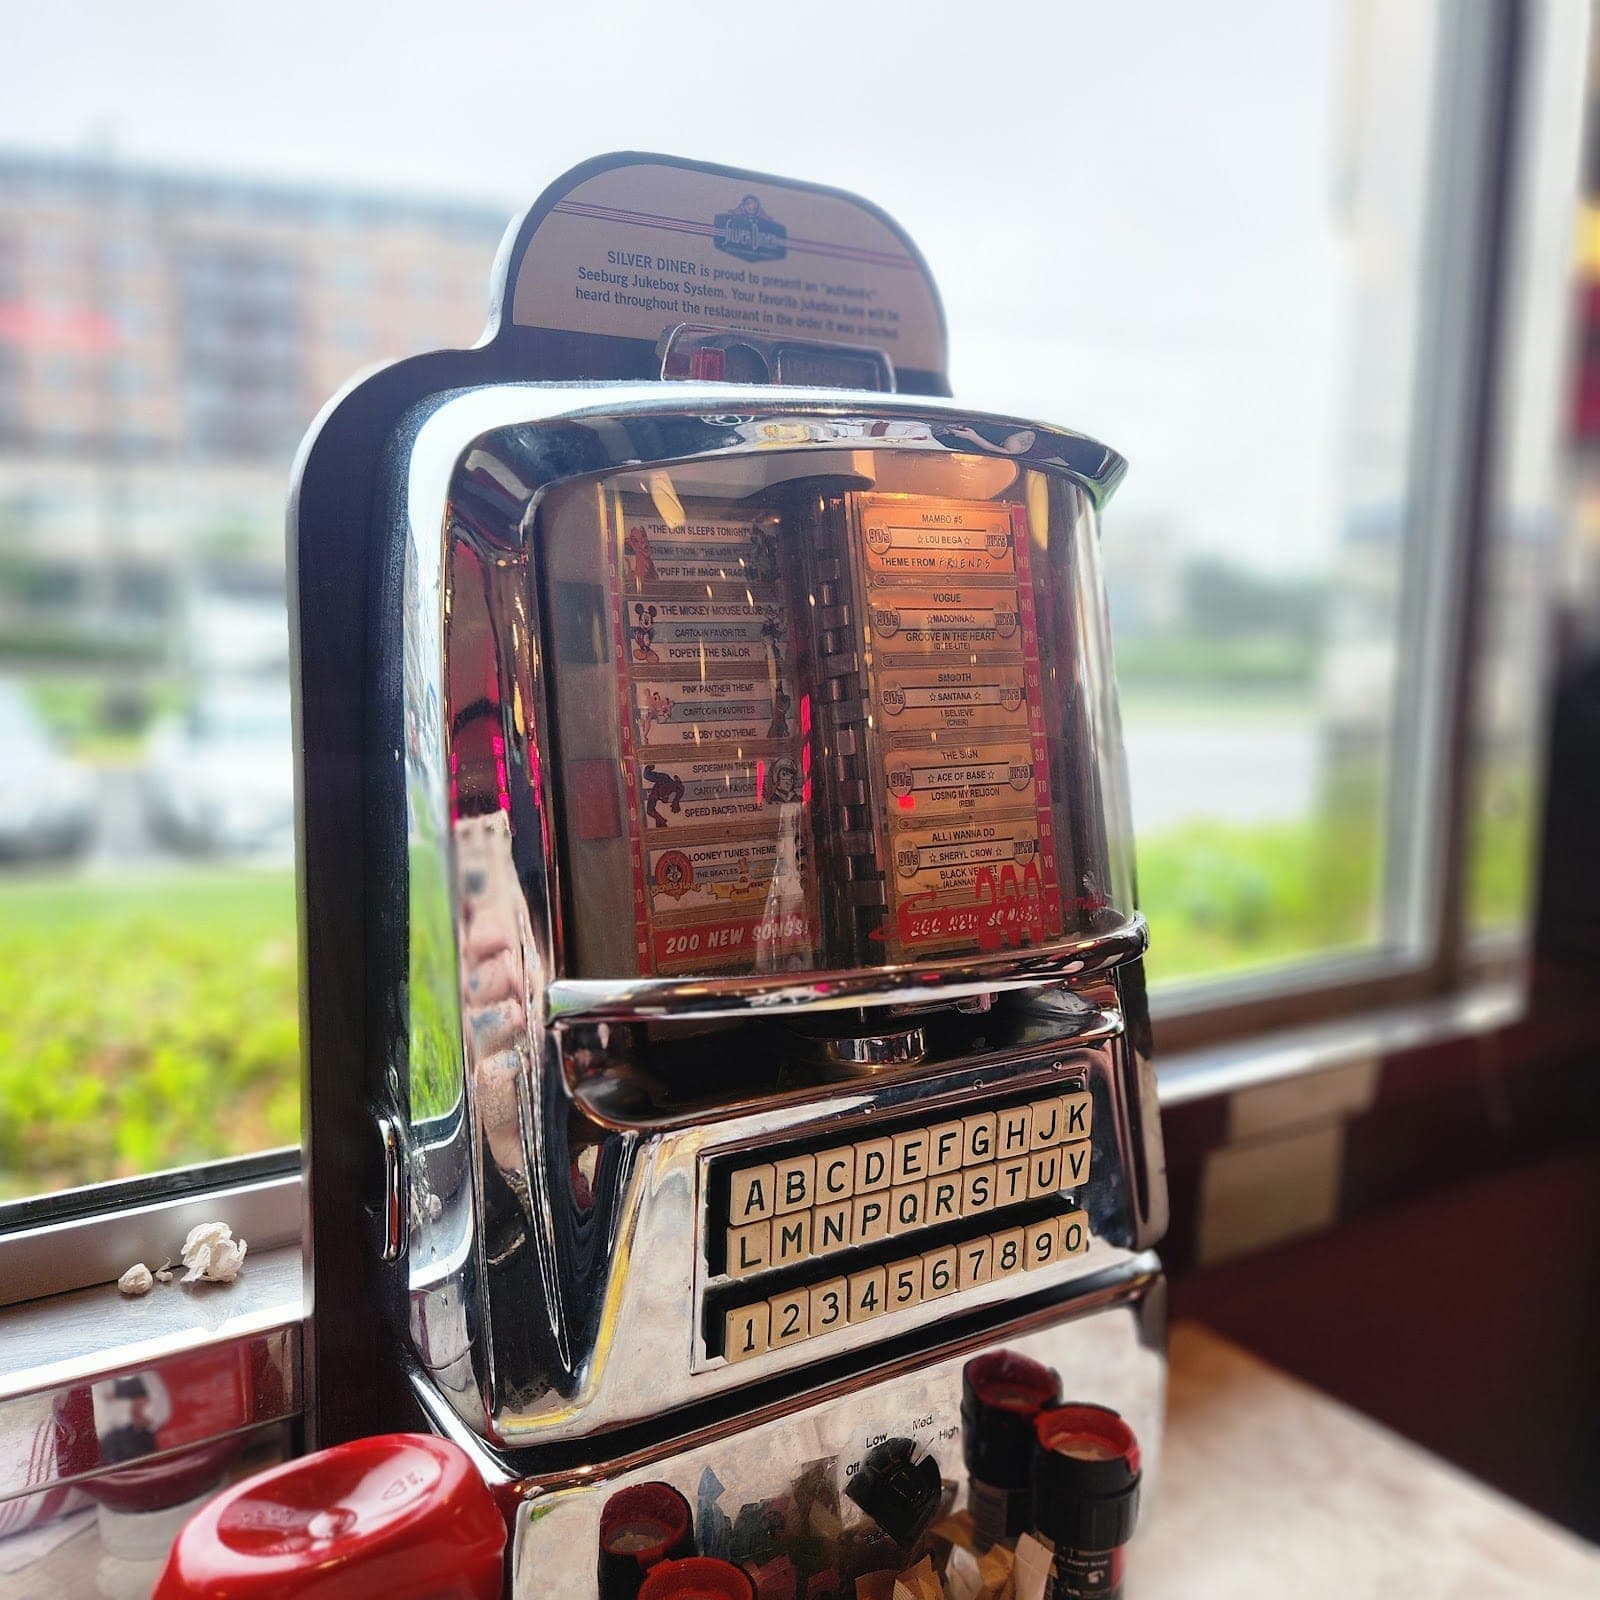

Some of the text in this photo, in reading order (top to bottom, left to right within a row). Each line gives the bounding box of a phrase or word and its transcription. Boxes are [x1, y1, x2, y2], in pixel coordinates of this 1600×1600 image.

[608, 250, 652, 269] SILVER
[657, 258, 696, 275] DINER
[700, 264, 710, 276] is
[714, 267, 744, 282] proud
[750, 270, 759, 283] to
[578, 266, 628, 288] Seeburg
[632, 275, 680, 292] Jukebox
[684, 281, 727, 299] System.
[732, 286, 754, 302] Your
[758, 292, 798, 308] favorite
[576, 286, 610, 302] heard
[615, 291, 678, 311] throughout
[682, 301, 700, 314] the
[704, 305, 759, 322] restaurant
[763, 312, 772, 324] in
[776, 313, 792, 326] the
[922, 514, 962, 524] MAMBO #5
[688, 526, 715, 536] SLEEPS
[926, 536, 962, 544] LOU BEGA
[880, 558, 909, 566] THEME
[912, 558, 935, 566] FROM
[682, 568, 695, 577] THE
[933, 594, 960, 602] VOGUE
[660, 606, 678, 616] THE
[680, 606, 710, 616] MICKEY
[712, 606, 740, 616] MOUSE
[932, 615, 970, 624] MADONNA
[675, 628, 746, 638] CARTOON FAVORITES
[906, 632, 996, 642] GROOVE IN THE HEART
[670, 648, 750, 658] POPEYE THE SAILOR
[938, 673, 972, 682] SMOOTH
[682, 684, 754, 694] PINK PANTHER THEME
[684, 706, 755, 716] CARTOON FAVORITES
[944, 709, 974, 717] BELIEVE
[732, 728, 757, 738] THEME
[942, 750, 978, 760] THE SIGN
[692, 762, 757, 774] SPIDERMAN THEME
[938, 771, 986, 781] ACE OF BASE
[694, 786, 728, 796] CARTOON
[931, 788, 1000, 800] LOSING MY RELIGON
[685, 803, 763, 818] SPEED RACER THEME
[932, 832, 948, 842] ALL
[954, 829, 982, 840] WANNA
[984, 828, 994, 836] DO
[688, 846, 776, 862] LOONEY TUNES THEME
[940, 848, 992, 860] SHERYL CROW
[710, 868, 738, 878] BEATLES
[940, 868, 966, 880] BLACK
[666, 934, 700, 954] 200
[708, 928, 744, 948] NEW
[744, 1102, 1086, 1215] A B C D E F G H J K
[740, 1151, 1086, 1269] L M N P Q R S T U V
[742, 1224, 1081, 1353] 1 2 3 4 5 6 7 8 9 0
[939, 1426, 959, 1440] High
[866, 1434, 888, 1448] Low
[846, 1462, 860, 1476] Off
